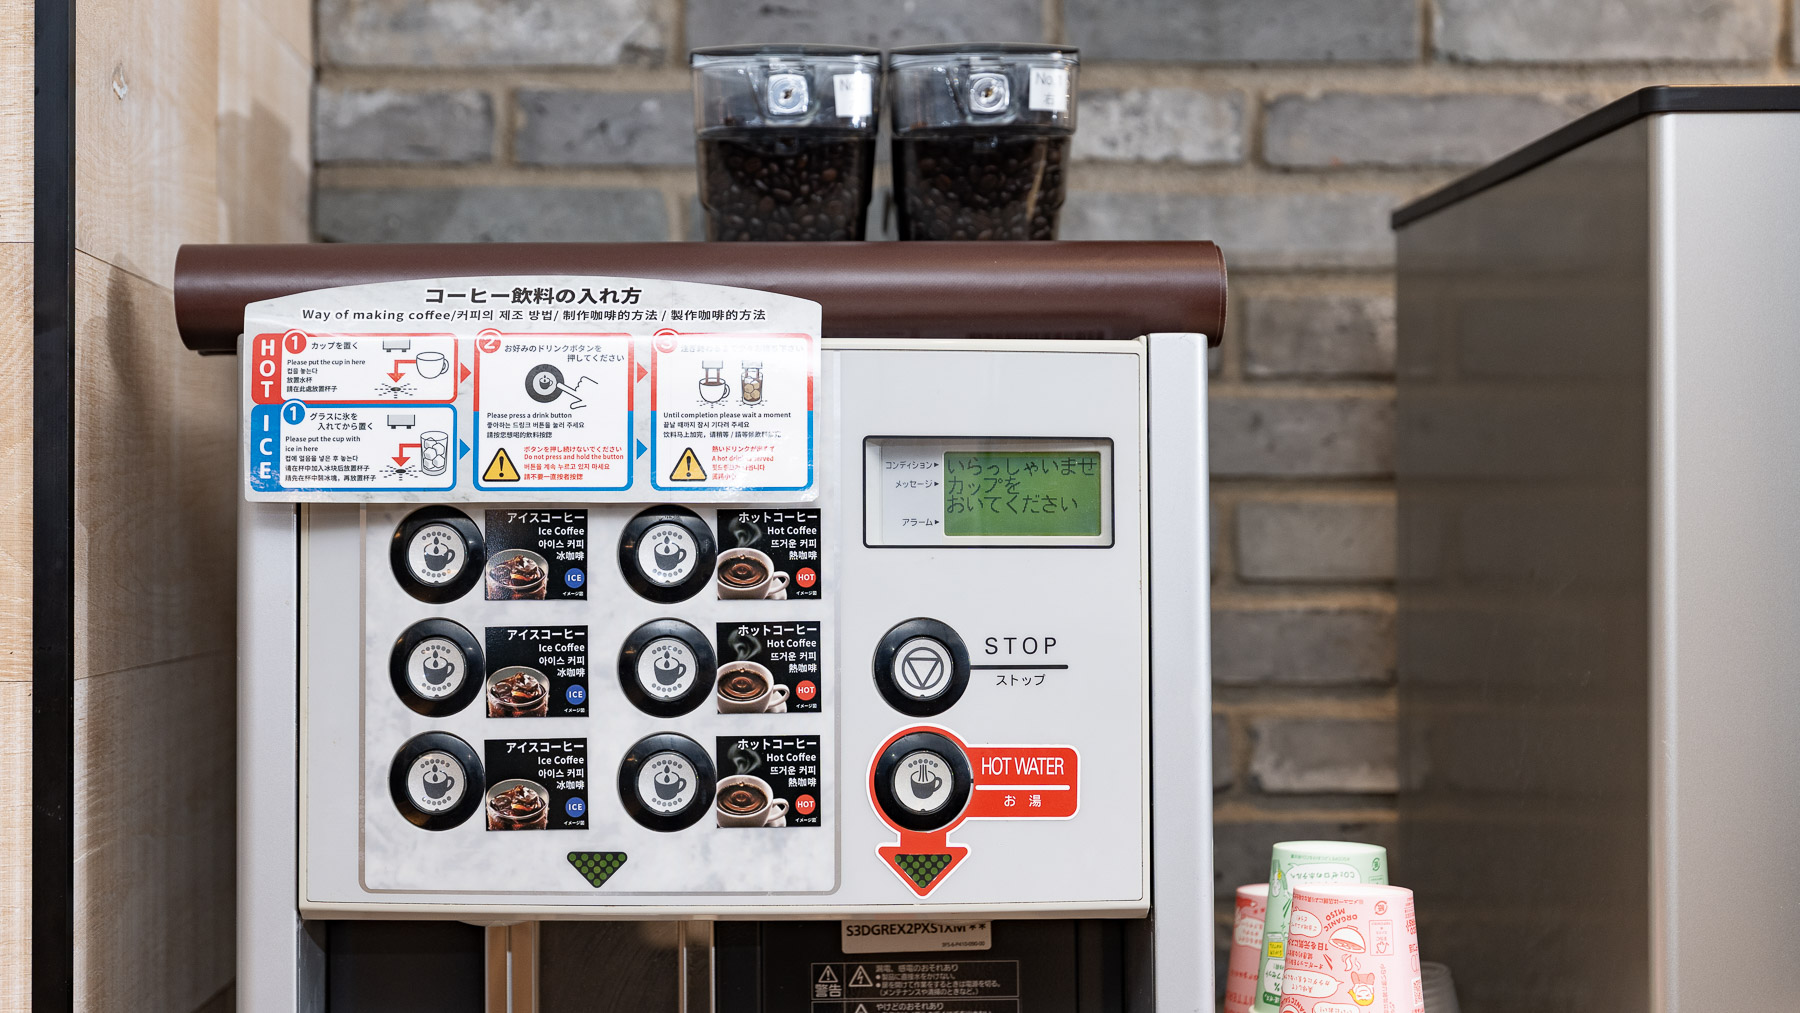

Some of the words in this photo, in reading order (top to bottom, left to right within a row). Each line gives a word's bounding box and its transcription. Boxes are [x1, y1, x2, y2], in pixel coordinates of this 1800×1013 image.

[425, 286, 642, 304] コーヒー飲料の入れ方
[302, 309, 331, 322] Way
[336, 309, 350, 320] of
[353, 309, 404, 322] making
[499, 309, 524, 321] 제조
[562, 309, 658, 322] 制作咖啡的方法
[670, 309, 766, 322] 製作咖啡的方法
[311, 341, 358, 350] カップを置く
[504, 344, 602, 353] お好みのドリンクボタンを
[567, 354, 625, 362] 押してください
[259, 338, 276, 398] HOT
[309, 412, 358, 421] グラスに氷を
[680, 412, 718, 420] completion
[719, 412, 741, 420] please
[318, 422, 374, 431] 入れてから置く
[306, 436, 320, 444] put
[259, 414, 273, 480] ICE
[885, 460, 933, 470] コンディション
[947, 457, 1097, 476] いらっしゃいませ
[895, 480, 933, 489] メッセージ
[948, 476, 1021, 496] カップを
[946, 495, 1078, 514] おいてください
[506, 512, 585, 524] アイスコーヒー
[738, 511, 818, 523] ホットコーヒー
[902, 518, 933, 527] アラーム
[538, 526, 552, 535] Ice
[554, 526, 585, 535] Coffee
[767, 526, 784, 535] Hot
[786, 526, 817, 535] Coffee
[538, 539, 564, 549] 아이스
[567, 539, 584, 549] 커피
[770, 539, 797, 549] 뜨거운
[799, 539, 817, 549] 커피
[556, 551, 585, 561] 冰咖啡
[789, 550, 817, 561] 熱咖啡
[567, 574, 582, 582] ICE
[798, 573, 815, 581] HOT
[507, 629, 585, 641] アイスコーヒー
[737, 625, 817, 637] ホットコーヒー
[538, 643, 553, 652] Ice
[555, 643, 585, 652] Coffee
[767, 639, 784, 648] Hot
[786, 639, 817, 648] Coffee
[984, 636, 1056, 654] STOP
[539, 656, 564, 666] 아이스
[567, 656, 585, 666] 커피
[770, 651, 797, 661] 뜨거운
[799, 651, 817, 661] 커피
[557, 667, 585, 678] 冰咖啡
[788, 663, 818, 673] 熱咖啡
[996, 674, 1046, 686] ストップ
[568, 691, 583, 699] ICE
[797, 686, 814, 694] HOT
[506, 742, 584, 754] アイスコーヒー
[737, 738, 817, 750] ホットコーヒー
[538, 756, 552, 765] Ice
[554, 755, 584, 765] Coffee
[766, 753, 783, 762] Hot
[786, 753, 816, 762] Coffee
[770, 765, 797, 775] 뜨거운
[799, 765, 816, 775] 커피
[981, 757, 1012, 776] HOT
[1014, 757, 1064, 776] WATER
[538, 769, 564, 778] 아이스
[567, 769, 584, 778] 커피
[556, 780, 585, 791] 冰咖啡
[788, 777, 817, 787] 熱咖啡
[568, 803, 583, 811] ICE
[1326, 908, 1346, 922] MISO
[1324, 914, 1358, 932] ORGANIC
[815, 984, 842, 998] 警告
[876, 1002, 944, 1011] やけどのおそれあり
